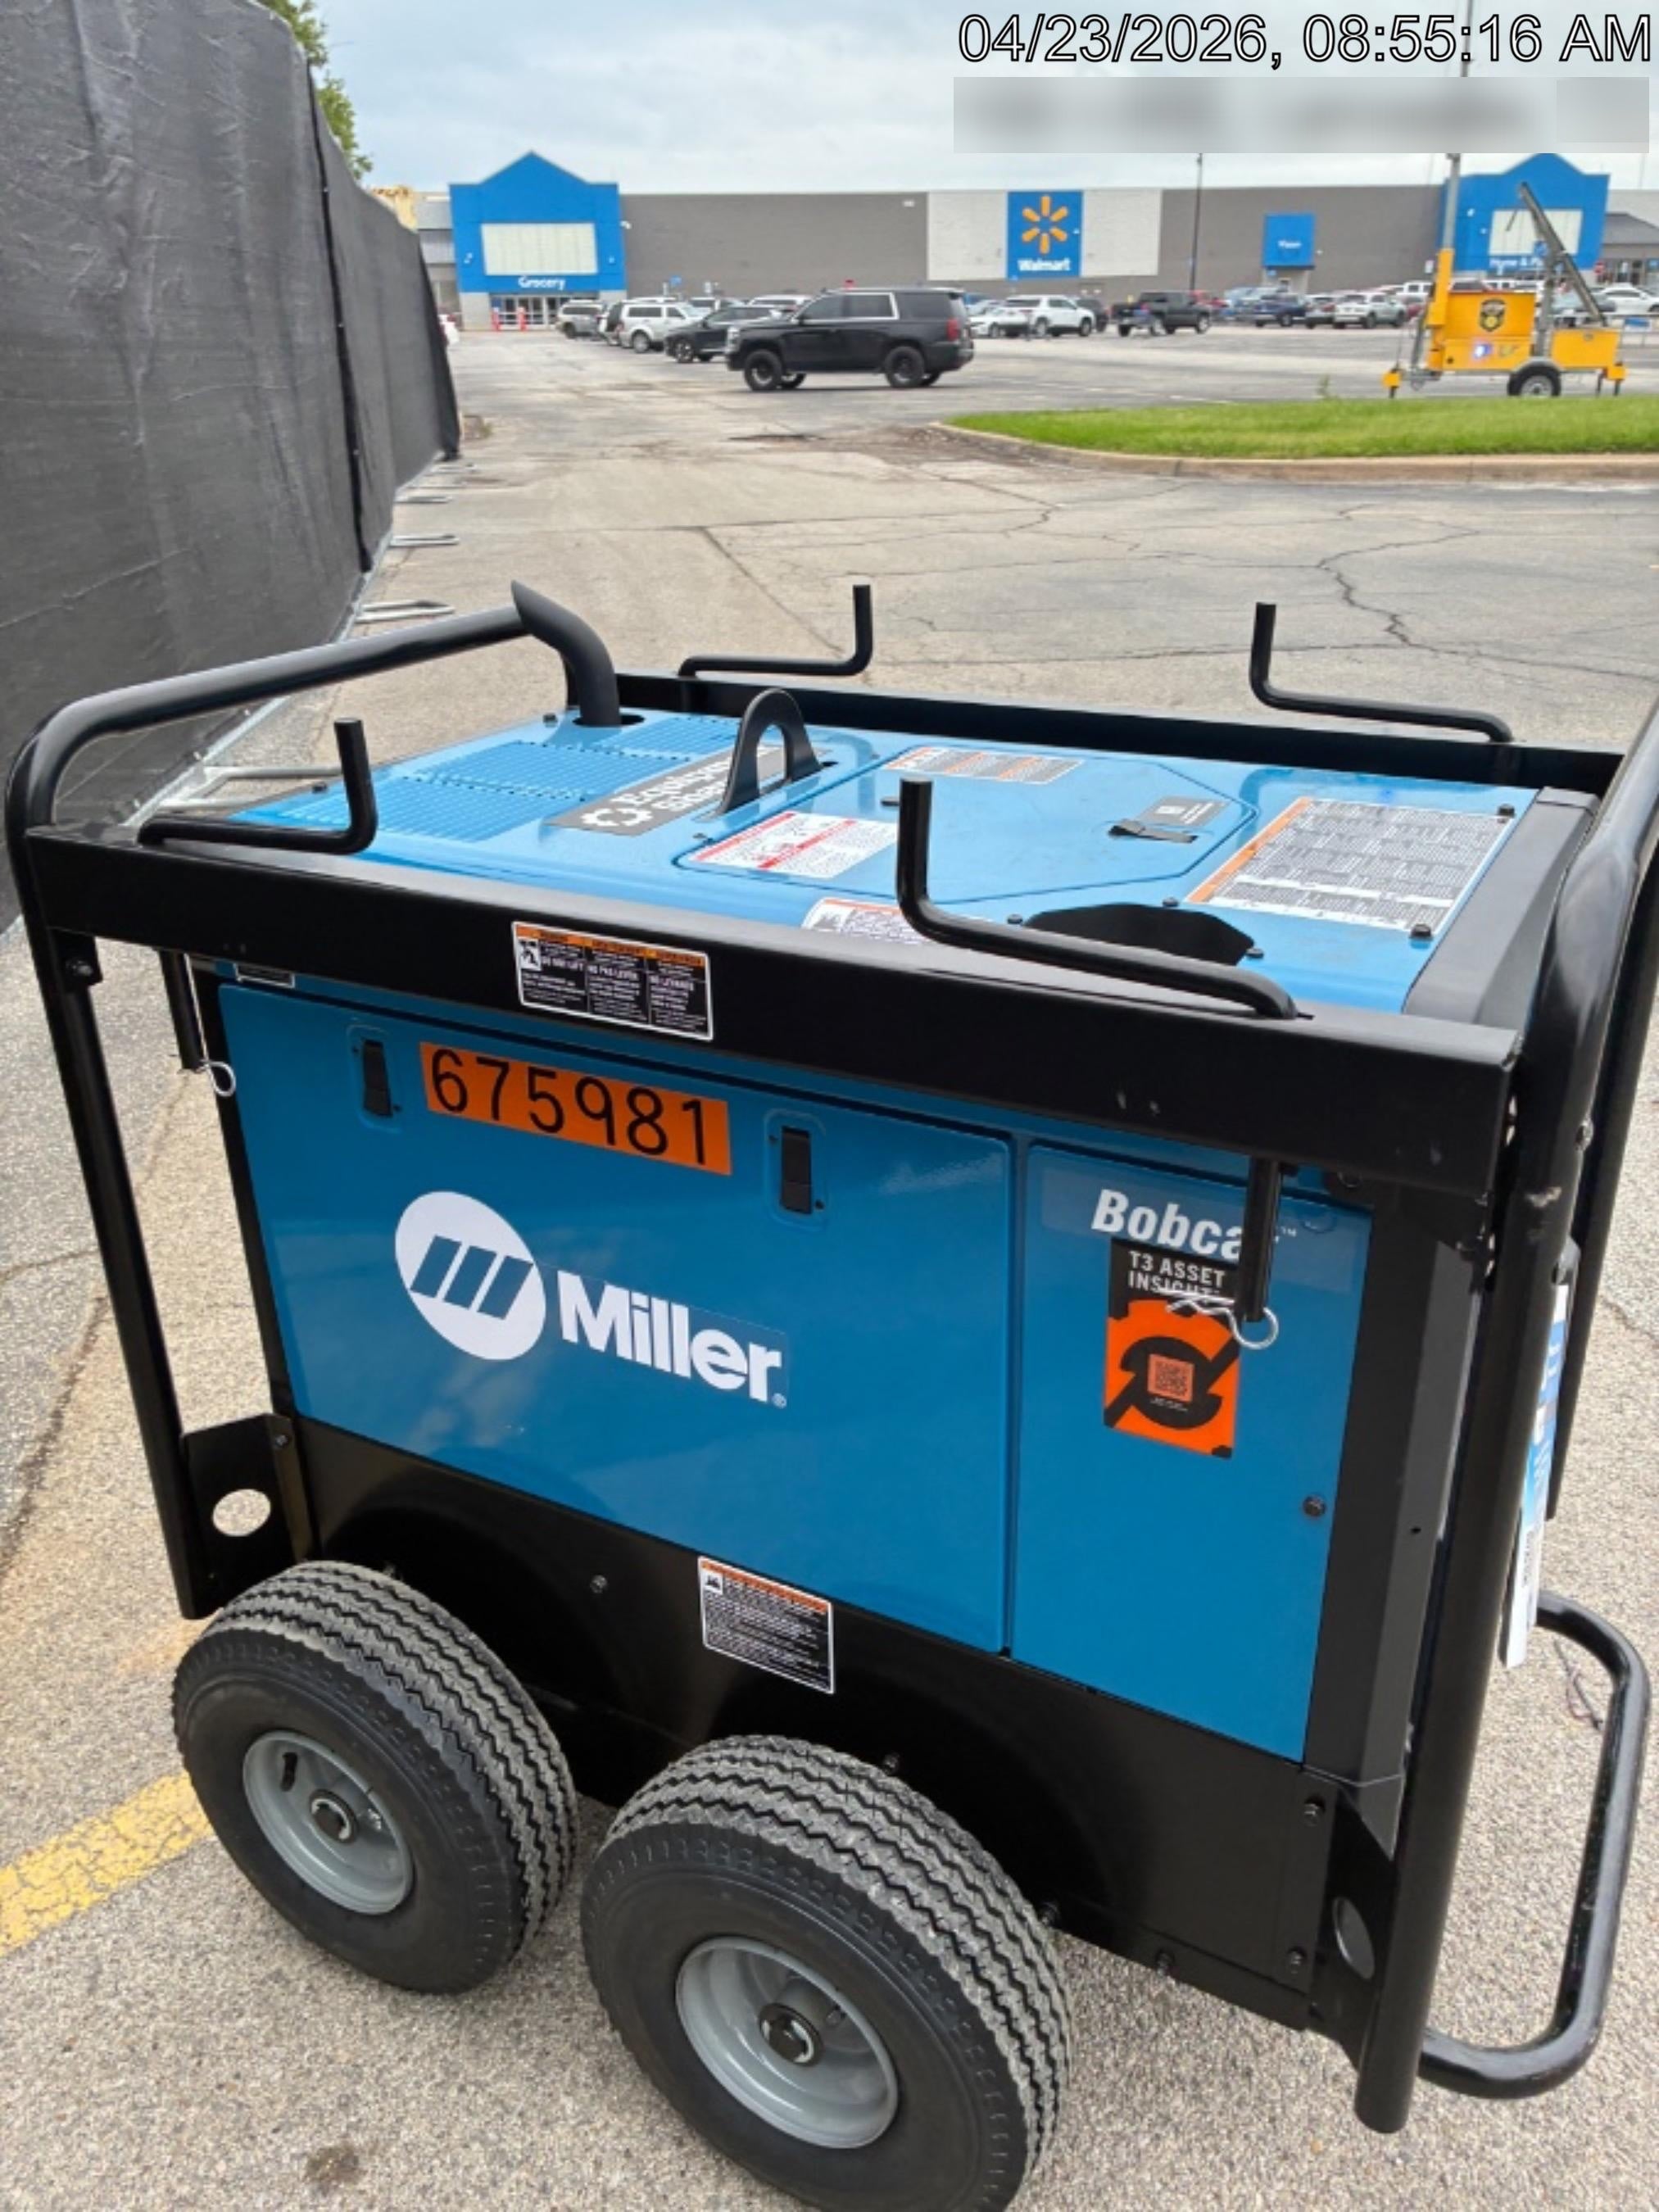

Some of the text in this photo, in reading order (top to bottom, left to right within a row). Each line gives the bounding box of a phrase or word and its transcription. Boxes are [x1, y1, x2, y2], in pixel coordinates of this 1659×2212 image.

[518, 275, 566, 291] Grocery
[1018, 257, 1070, 271] Walmart
[432, 1049, 705, 1165] 675981
[1091, 1189, 1280, 1260] Bobca
[1129, 1251, 1225, 1288] T3 ASSET
[557, 1270, 782, 1403] Miller
